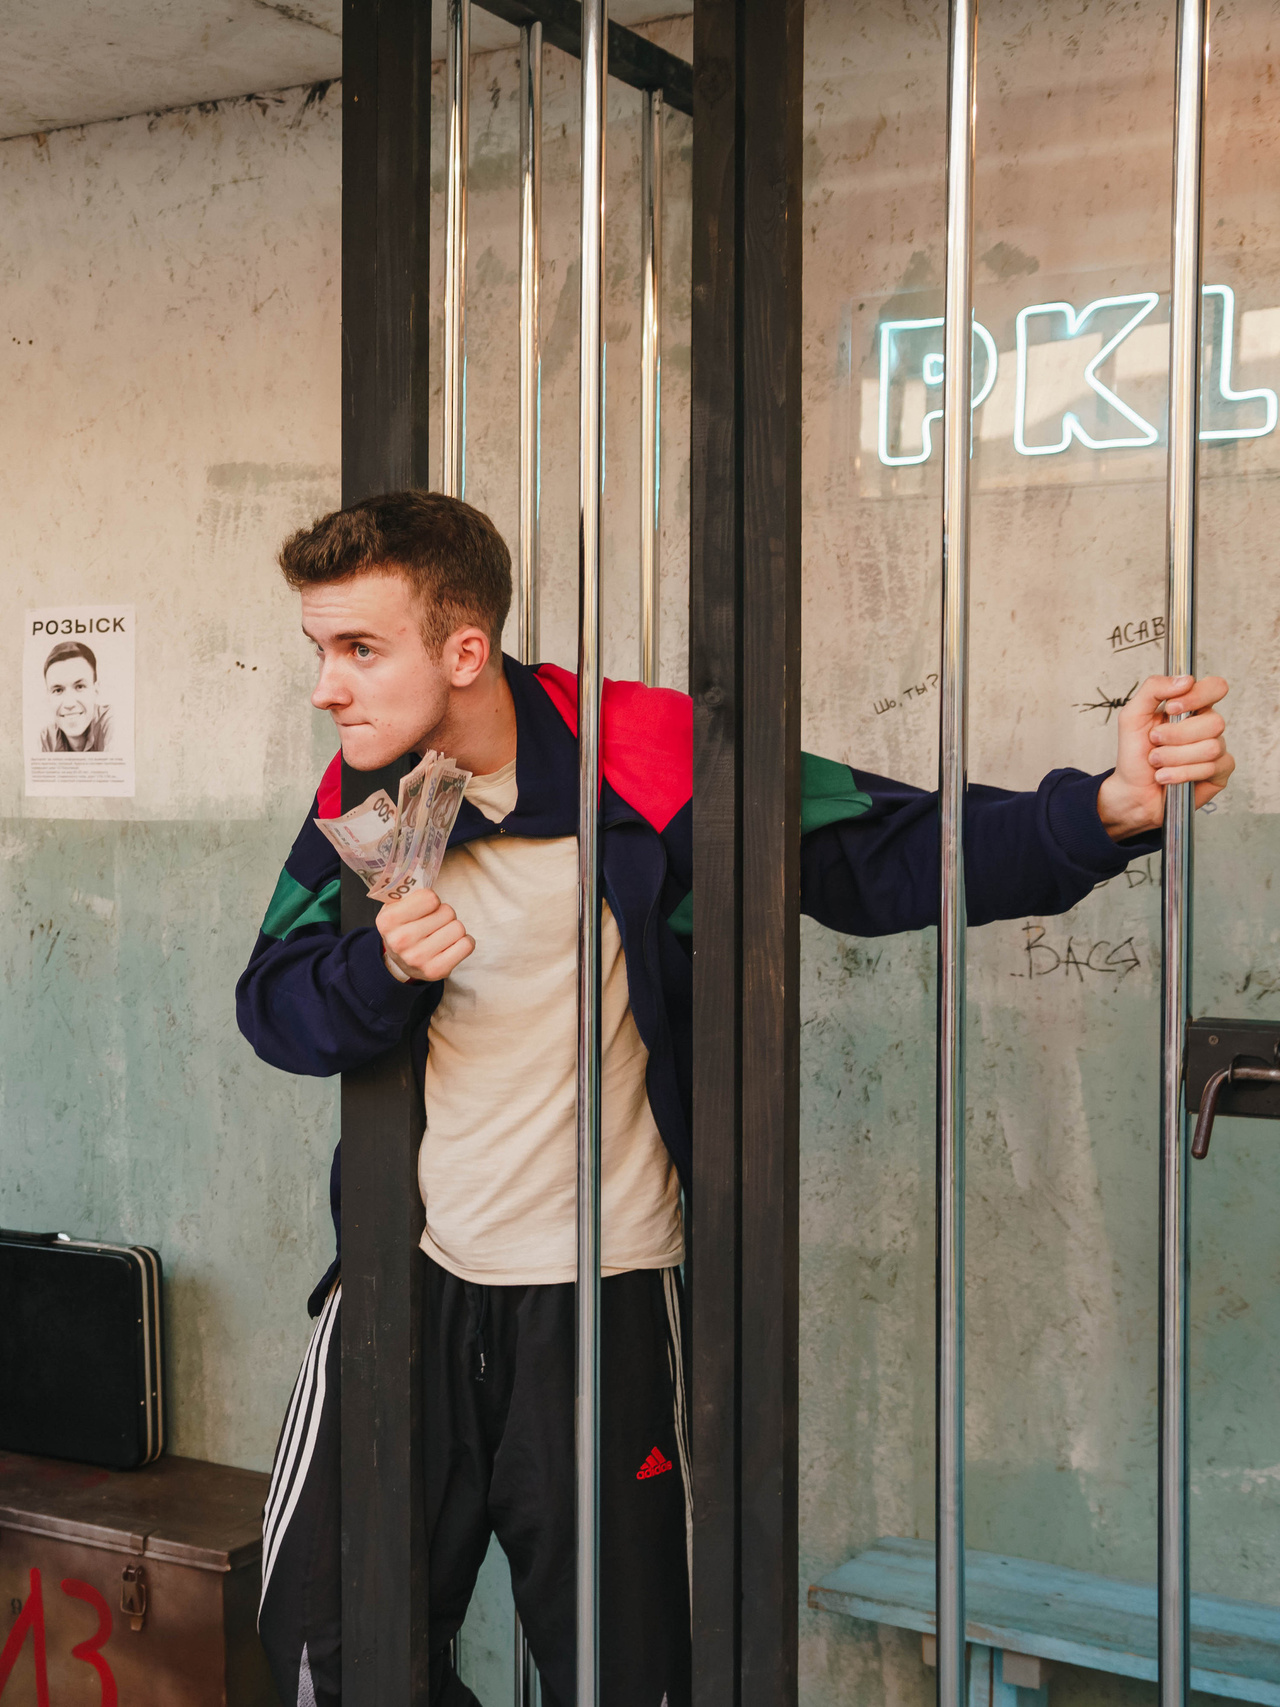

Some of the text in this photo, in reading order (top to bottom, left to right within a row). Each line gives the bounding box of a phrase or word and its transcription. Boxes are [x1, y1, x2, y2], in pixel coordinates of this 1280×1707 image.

[877, 283, 1279, 467] PKL
[32, 616, 125, 636] РОЗЫСК
[1106, 616, 1166, 648] ACAB
[373, 797, 395, 824] 500
[387, 875, 418, 900] 500
[636, 1460, 672, 1480] adidas
